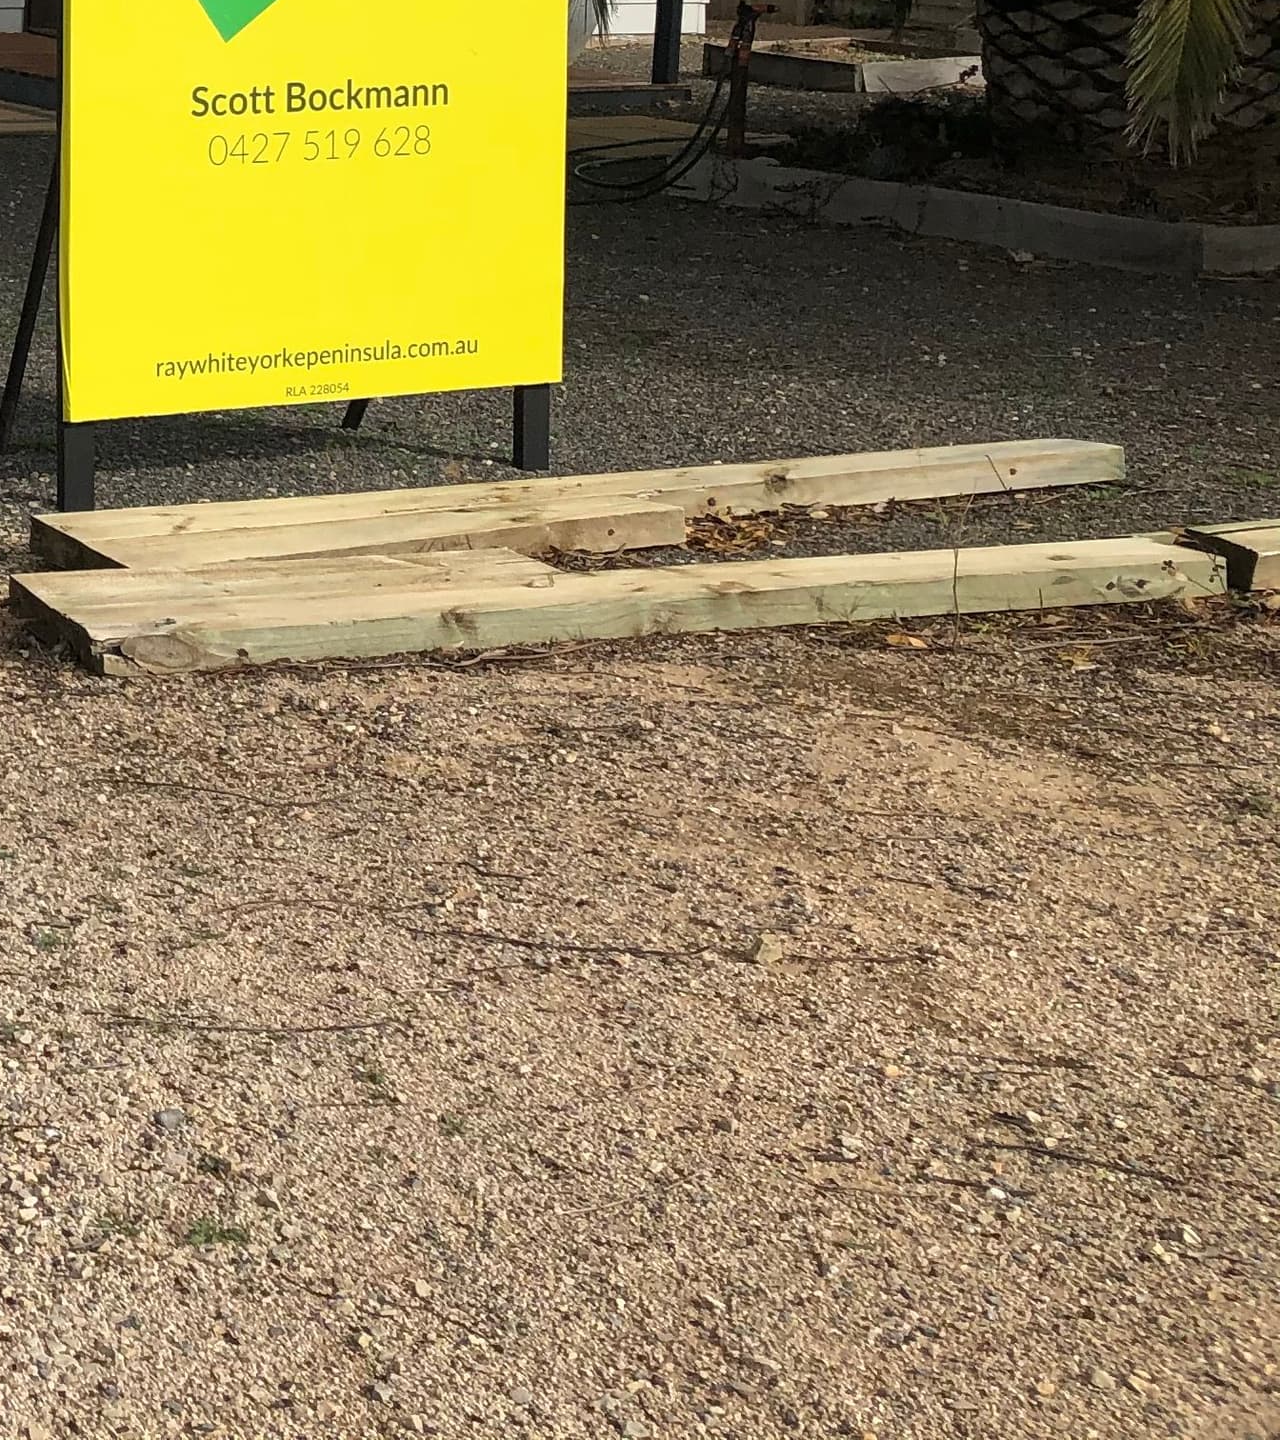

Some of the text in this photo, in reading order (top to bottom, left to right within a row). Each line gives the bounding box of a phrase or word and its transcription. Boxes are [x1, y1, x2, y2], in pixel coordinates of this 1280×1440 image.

[191, 78, 449, 118] Scott Bockmann
[208, 124, 431, 166] 0427 519 628
[155, 339, 479, 381] raywhiteyorkepeninsula.com.au
[285, 382, 350, 398] RLA 228054
